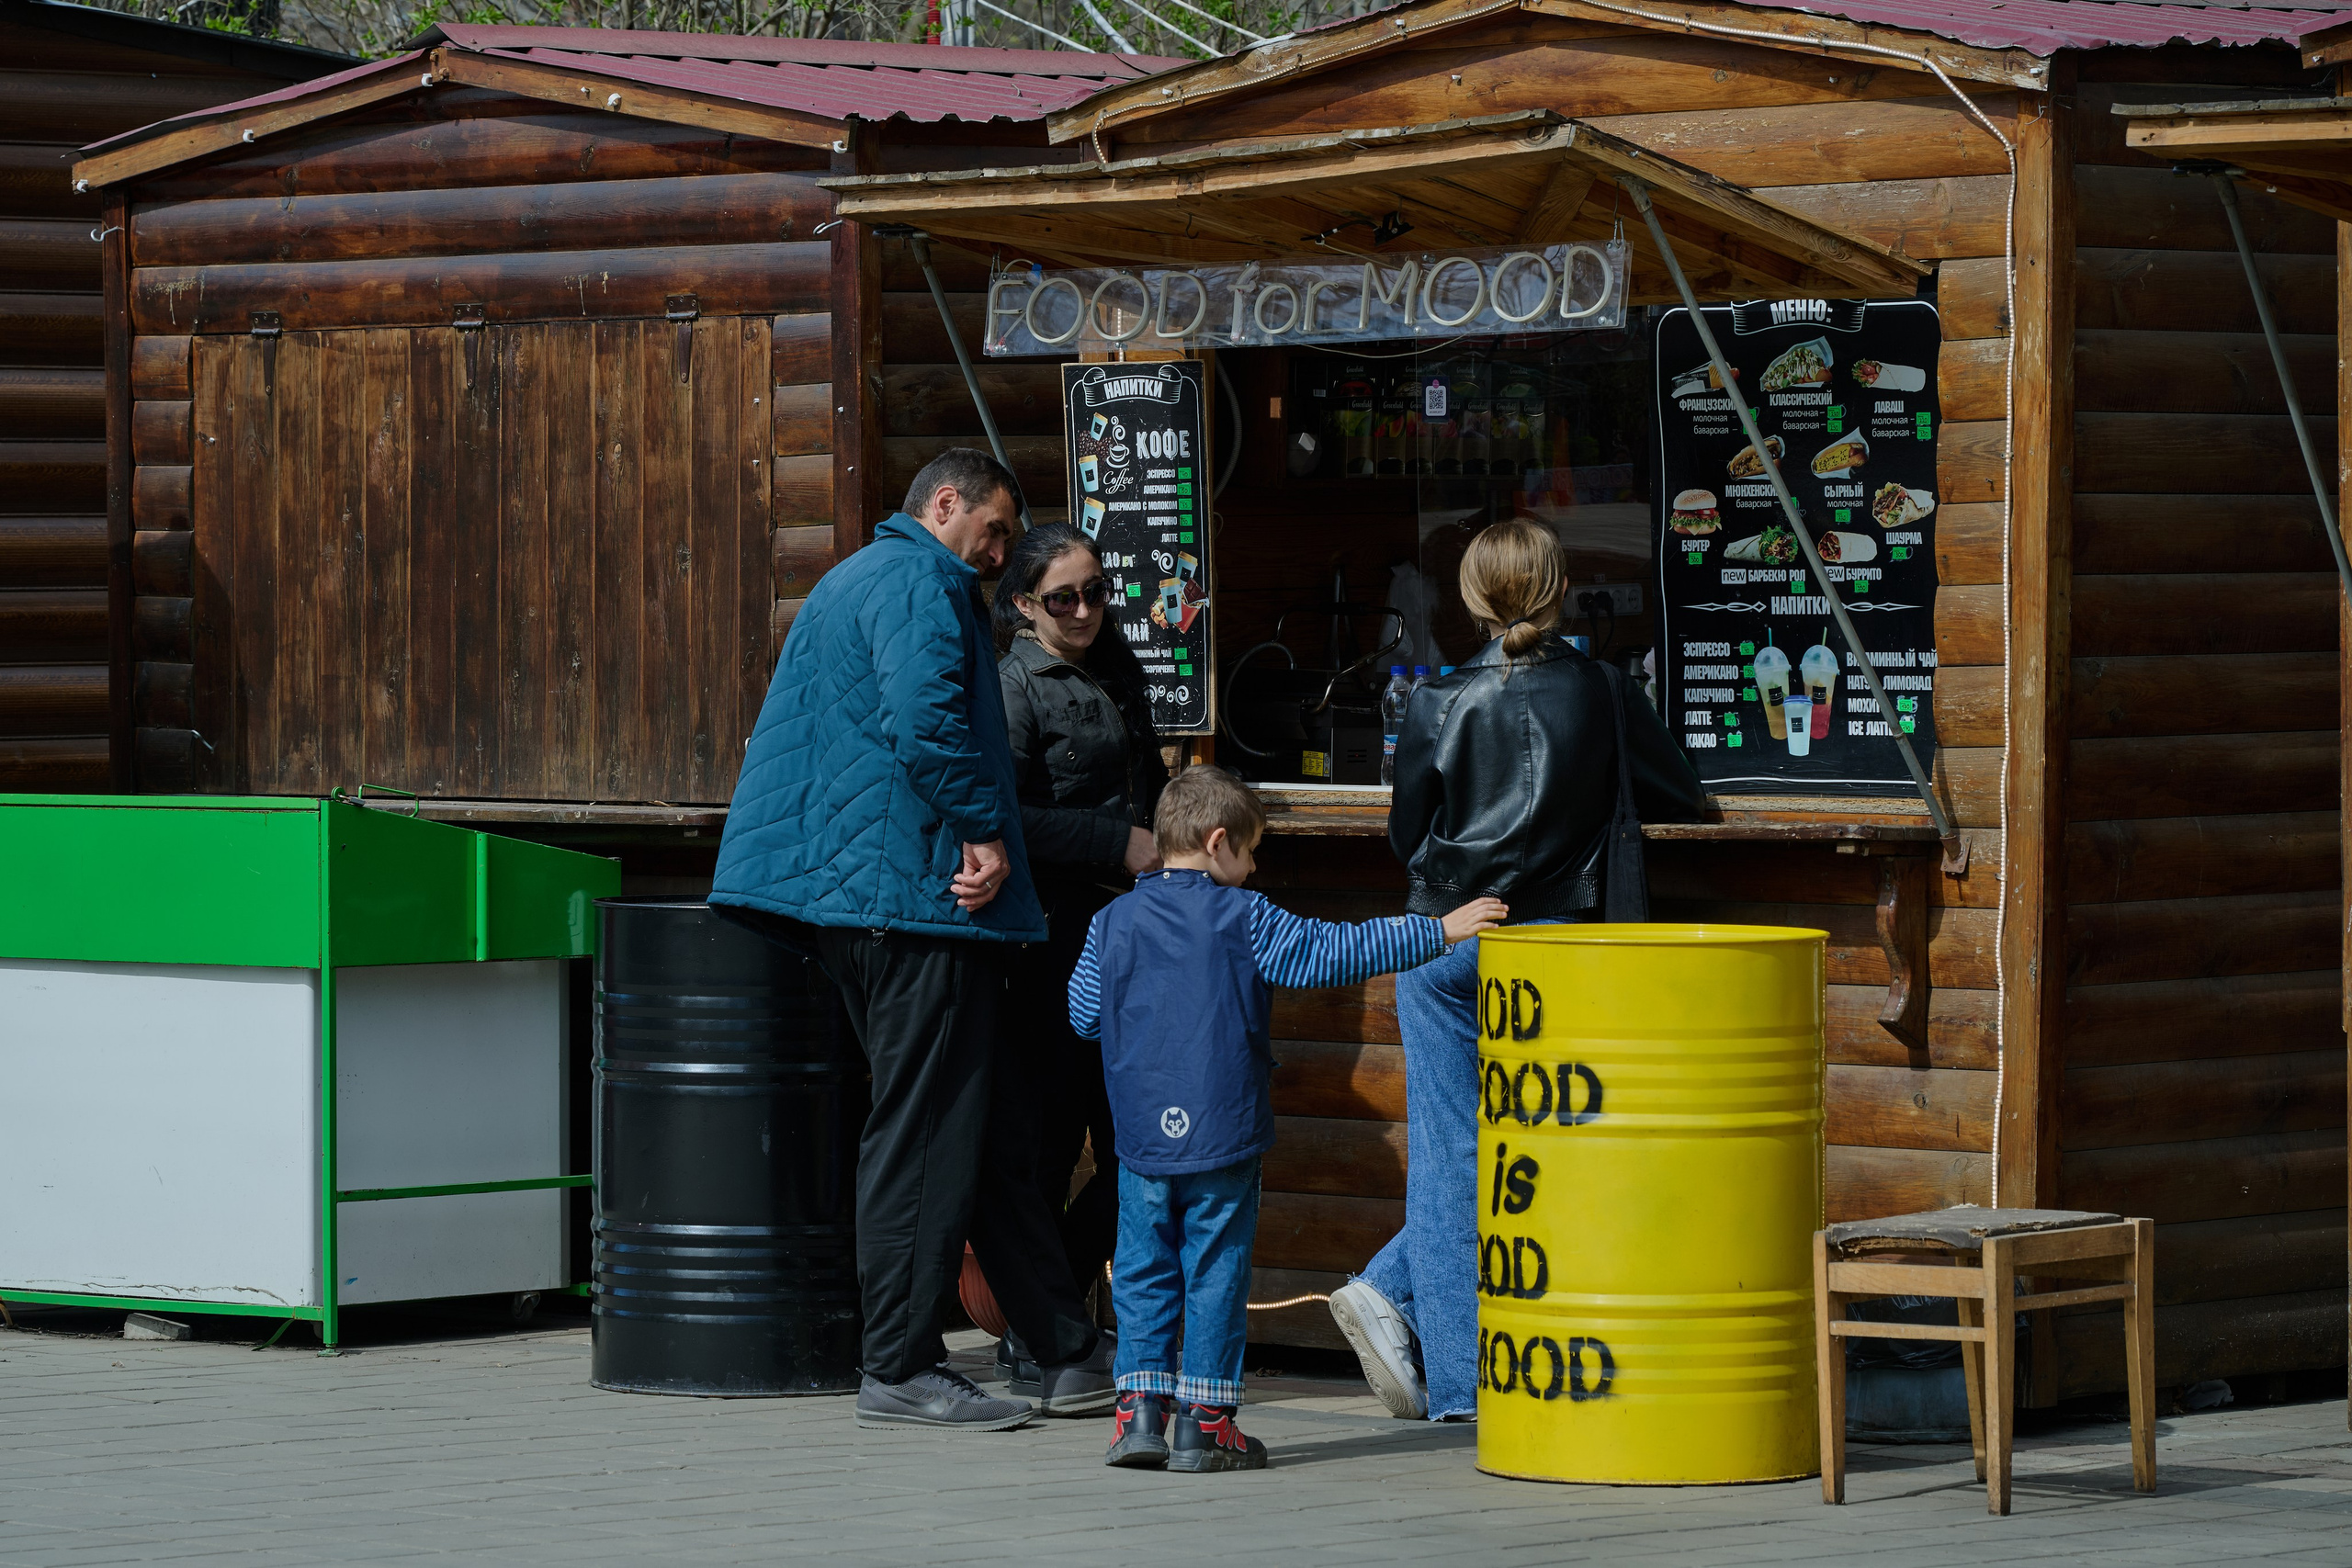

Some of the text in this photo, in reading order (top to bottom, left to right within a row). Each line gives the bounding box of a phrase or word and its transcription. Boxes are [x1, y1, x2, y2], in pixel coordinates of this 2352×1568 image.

[988, 246, 1614, 349] FOOD for MOOD
[1770, 299, 1833, 324] МЕНЮ:
[1103, 378, 1163, 400] НАПИТКИ
[1770, 389, 1833, 406] КЛАССИЧЕСКИЙ
[1679, 398, 1737, 412] ФРАНЦУЗСКИ
[1873, 400, 1905, 413] ЛАВАШ
[1692, 414, 1728, 423] молочная
[1782, 409, 1819, 418] молочная
[1871, 415, 1908, 425] молочная
[1693, 424, 1729, 435] баварская
[1782, 421, 1820, 431] баварская
[1871, 427, 1910, 439] баварская
[1136, 429, 1191, 460] КОФЕ
[1147, 468, 1176, 479] ЭСПРЕССО
[1102, 468, 1135, 495] Coffee
[1143, 484, 1177, 494] АМЕРИКАНО
[1724, 484, 1779, 497] МЮНХЕНСКИ
[1824, 481, 1864, 498] СЫРНЫЙ
[1108, 500, 1178, 511] АМЕРИКАНО С МОЛОКОМ
[1736, 498, 1772, 510] баварская
[1826, 499, 1864, 509] молочная
[1147, 516, 1178, 526] КАПУЧИНО
[1161, 533, 1178, 543] ЛАТТЕ
[1886, 532, 1922, 545] ШАУРМА
[1681, 539, 1710, 552] БУРГЕР
[1723, 569, 1806, 582] new БАРБЕКЮ РОЛ
[1827, 567, 1883, 581] ew БУРРИТО
[1770, 595, 1831, 615] НАПИТКИ
[1124, 617, 1149, 642] ЧАЙ
[1683, 641, 1731, 658] ЭСПРЕССО
[1917, 648, 1938, 667] ЧАЙ
[1683, 664, 1739, 681] АМЕРИКАНО
[1883, 675, 1933, 691] ЛИМОНАД
[1684, 687, 1736, 703] КАПУЧИНО
[1847, 697, 1881, 714] МОХИТ
[1684, 710, 1713, 726] ЛАТТЕ
[1848, 720, 1864, 736] ICE
[1685, 733, 1717, 749] КАКАО
[1491, 1142, 1541, 1217] is
